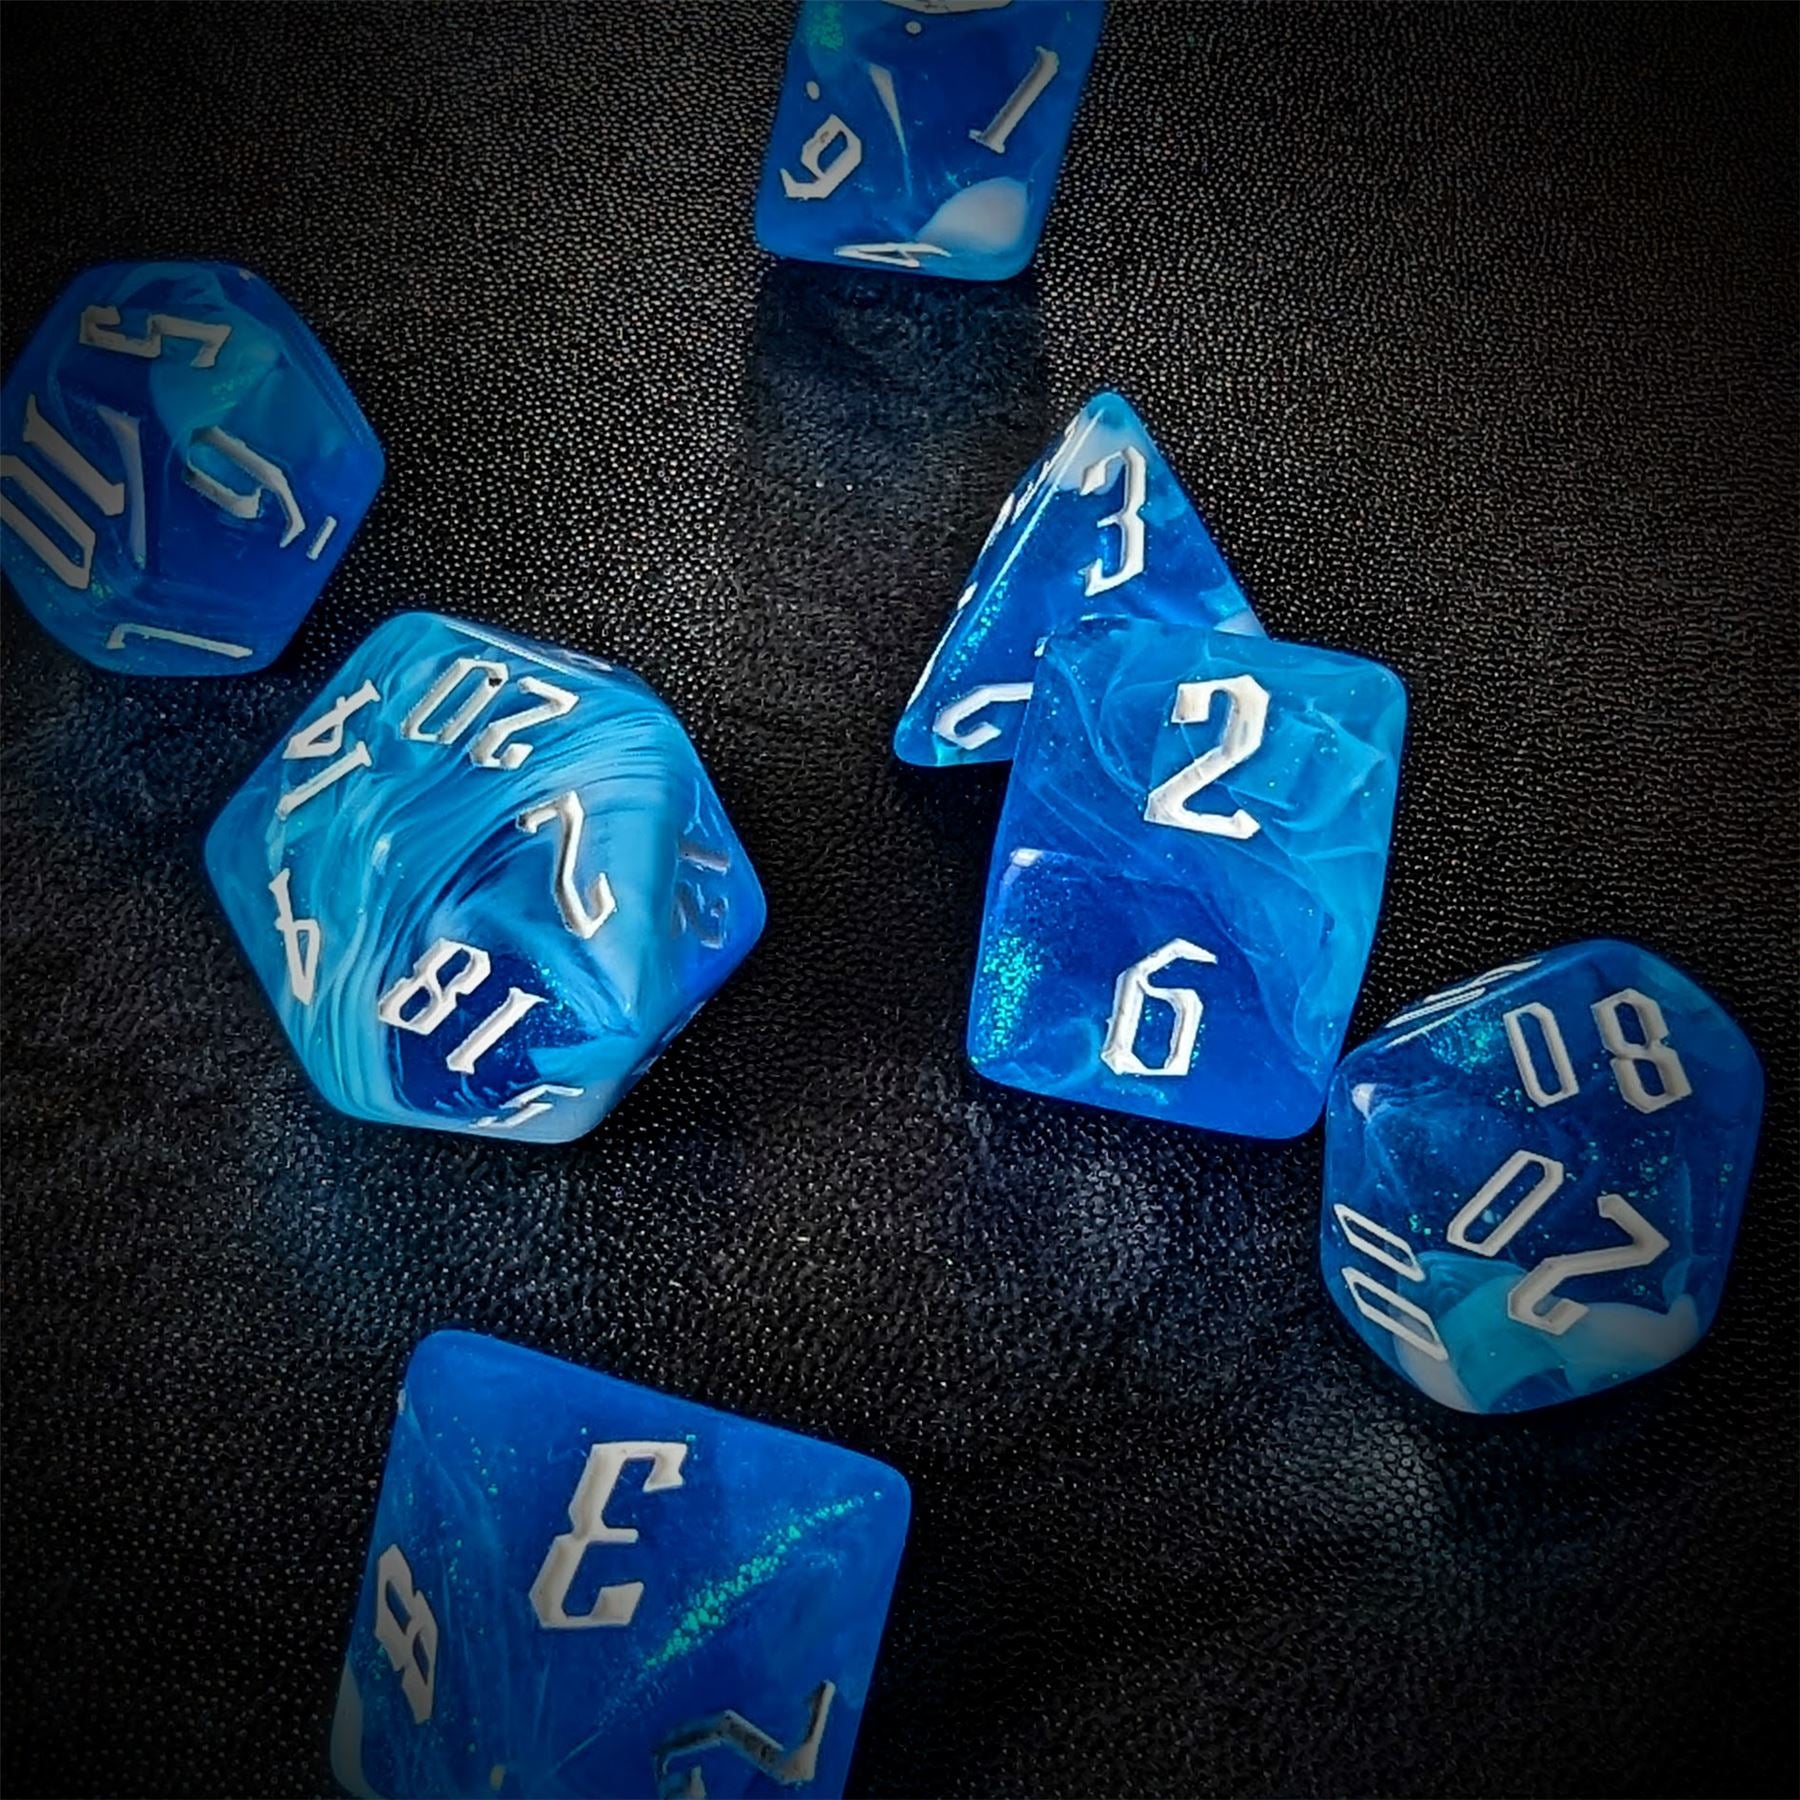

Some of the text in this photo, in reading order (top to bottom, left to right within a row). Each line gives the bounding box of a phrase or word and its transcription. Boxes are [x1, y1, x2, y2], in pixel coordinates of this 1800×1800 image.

[968, 46, 1060, 154] 1
[79, 304, 233, 369] 5
[1079, 445, 1147, 598] 3
[281, 679, 381, 823] 14
[403, 656, 580, 771] 20
[1143, 674, 1271, 840] 2
[515, 790, 618, 940] 2
[267, 867, 323, 1007] 4
[377, 935, 548, 1076] 18
[1100, 936, 1218, 1077] 6
[1502, 987, 1693, 1114] 80
[1446, 1149, 1671, 1337] 20
[528, 1441, 688, 1629] 3
[373, 1543, 439, 1725] 8
